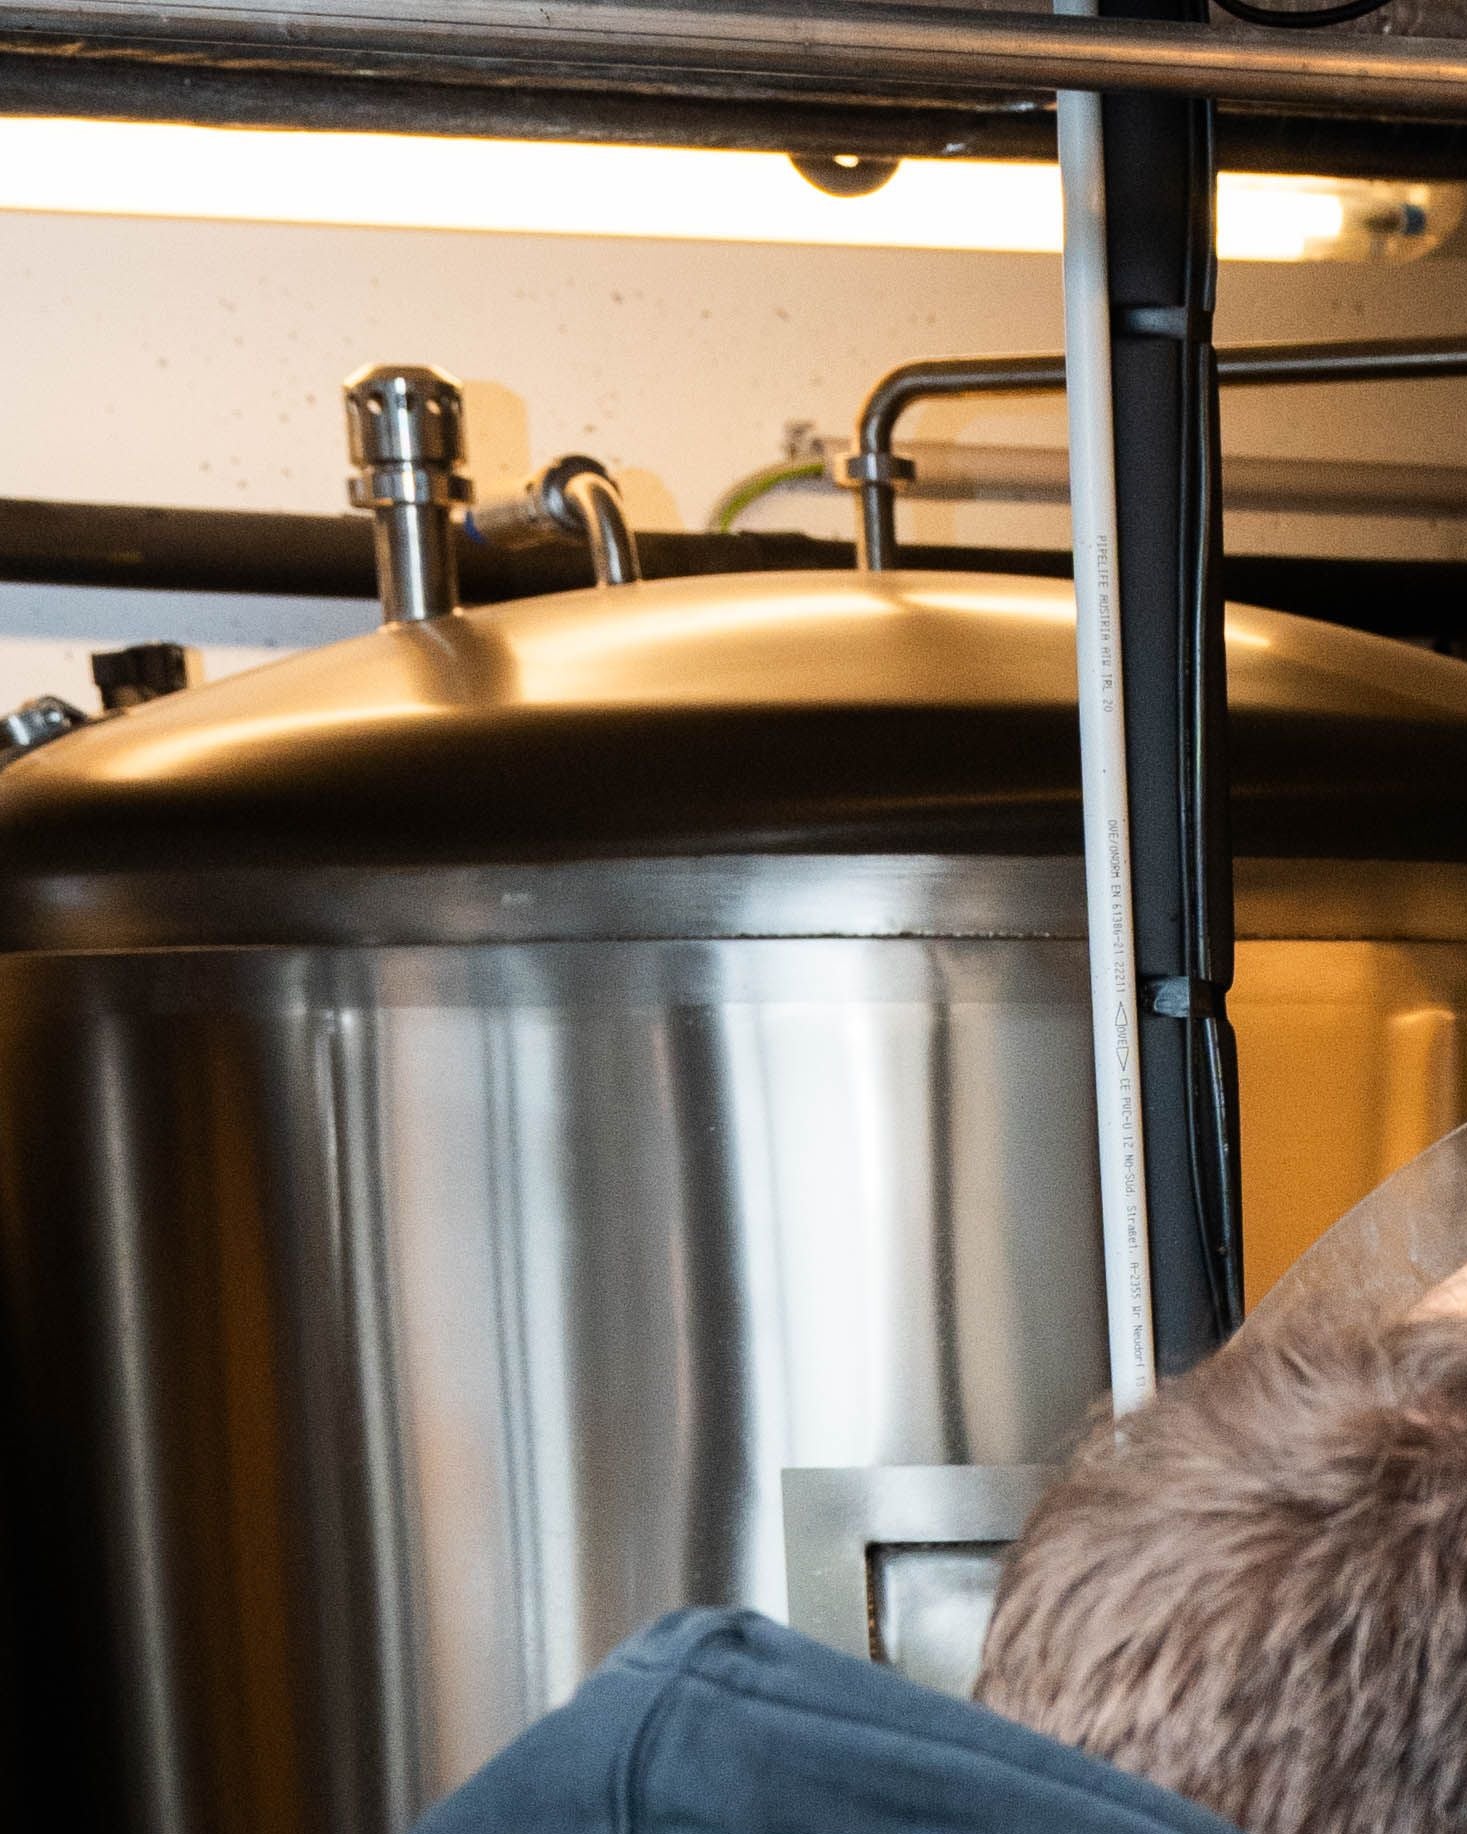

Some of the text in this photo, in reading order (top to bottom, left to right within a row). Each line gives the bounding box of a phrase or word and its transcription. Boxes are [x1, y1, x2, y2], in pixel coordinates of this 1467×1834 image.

[1096, 534, 1110, 588] PIPELIFE
[1098, 594, 1111, 641] AUSTRIA
[1102, 698, 1113, 713] 20
[1111, 885, 1124, 898] EN
[1114, 962, 1126, 993] 22211
[1121, 1097, 1132, 1129] PVC-U
